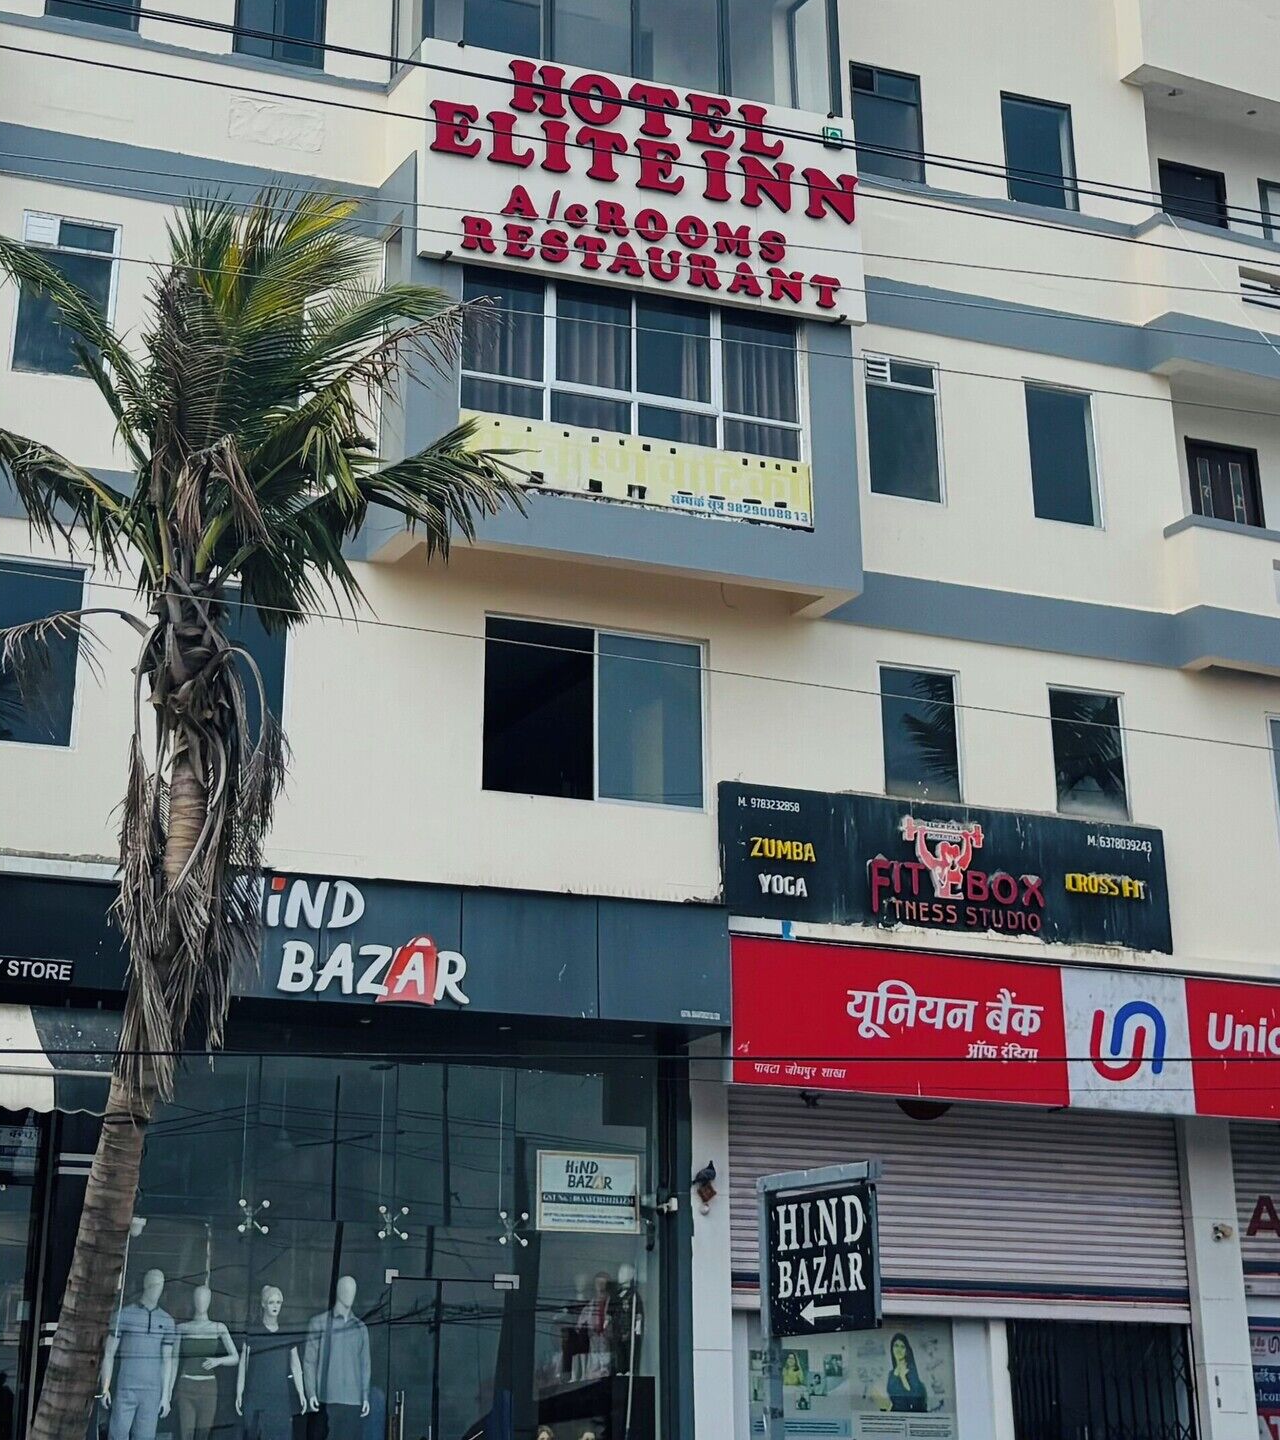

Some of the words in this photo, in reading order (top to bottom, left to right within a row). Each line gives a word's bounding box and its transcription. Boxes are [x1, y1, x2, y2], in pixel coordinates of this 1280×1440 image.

[508, 59, 784, 158] HOTEL
[429, 100, 685, 195] ELITE
[701, 150, 859, 225] INN
[595, 199, 787, 262] ROOMS
[460, 216, 841, 309] RESTAURANT
[727, 502, 809, 523] 9829008813
[751, 798, 800, 813] 9783232858
[750, 837, 816, 862] ZUMBA
[1099, 836, 1152, 853] 6378039243
[758, 873, 808, 897] YOGA
[867, 859, 926, 913] FIT
[967, 870, 1045, 908] BOX
[1065, 873, 1120, 896] CROSS
[966, 906, 1042, 932] STUDIO
[6, 958, 73, 982] STORE
[277, 936, 470, 1005] BAZAR
[846, 979, 979, 1039] यूनियन
[985, 988, 1044, 1036] बैंक
[776, 1194, 864, 1252] HIND
[777, 1251, 867, 1299] BAZAR
